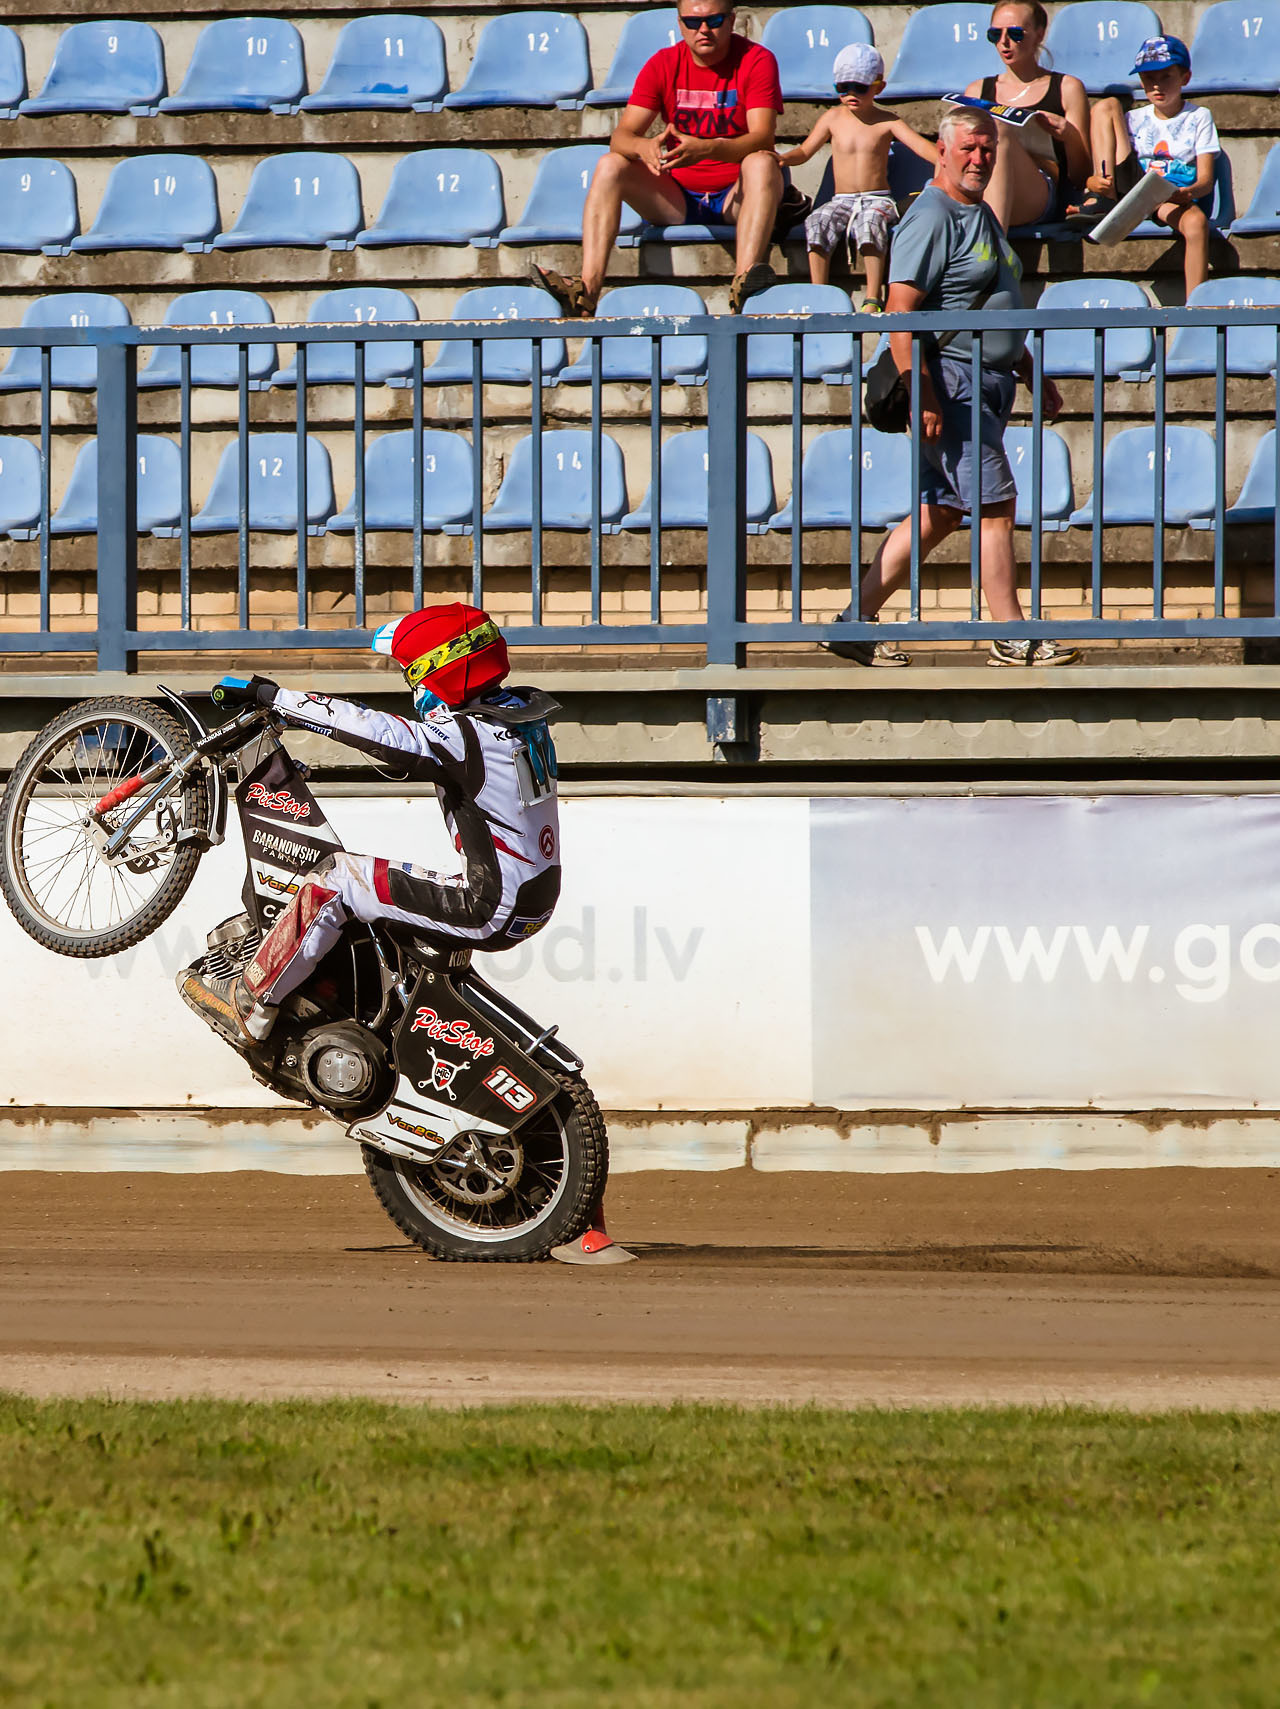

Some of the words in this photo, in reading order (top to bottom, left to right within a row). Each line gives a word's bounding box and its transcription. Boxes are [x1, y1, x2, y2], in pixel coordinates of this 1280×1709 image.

[953, 22, 978, 43] 15
[1097, 20, 1119, 41] 16
[1241, 17, 1263, 38] 17
[107, 36, 118, 54] 9
[246, 36, 268, 57] 10
[384, 37, 404, 57] 11
[527, 32, 550, 53] 12
[806, 29, 829, 49] 14
[20, 173, 31, 192] 9
[153, 175, 177, 196] 10
[294, 177, 320, 196] 11
[436, 173, 460, 193] 12
[259, 457, 283, 477] 12
[556, 451, 582, 471] 14
[245, 782, 311, 820] PitStop
[914, 922, 1280, 1002] www.go
[410, 1006, 495, 1060] PitStop
[484, 1068, 535, 1111] 113
